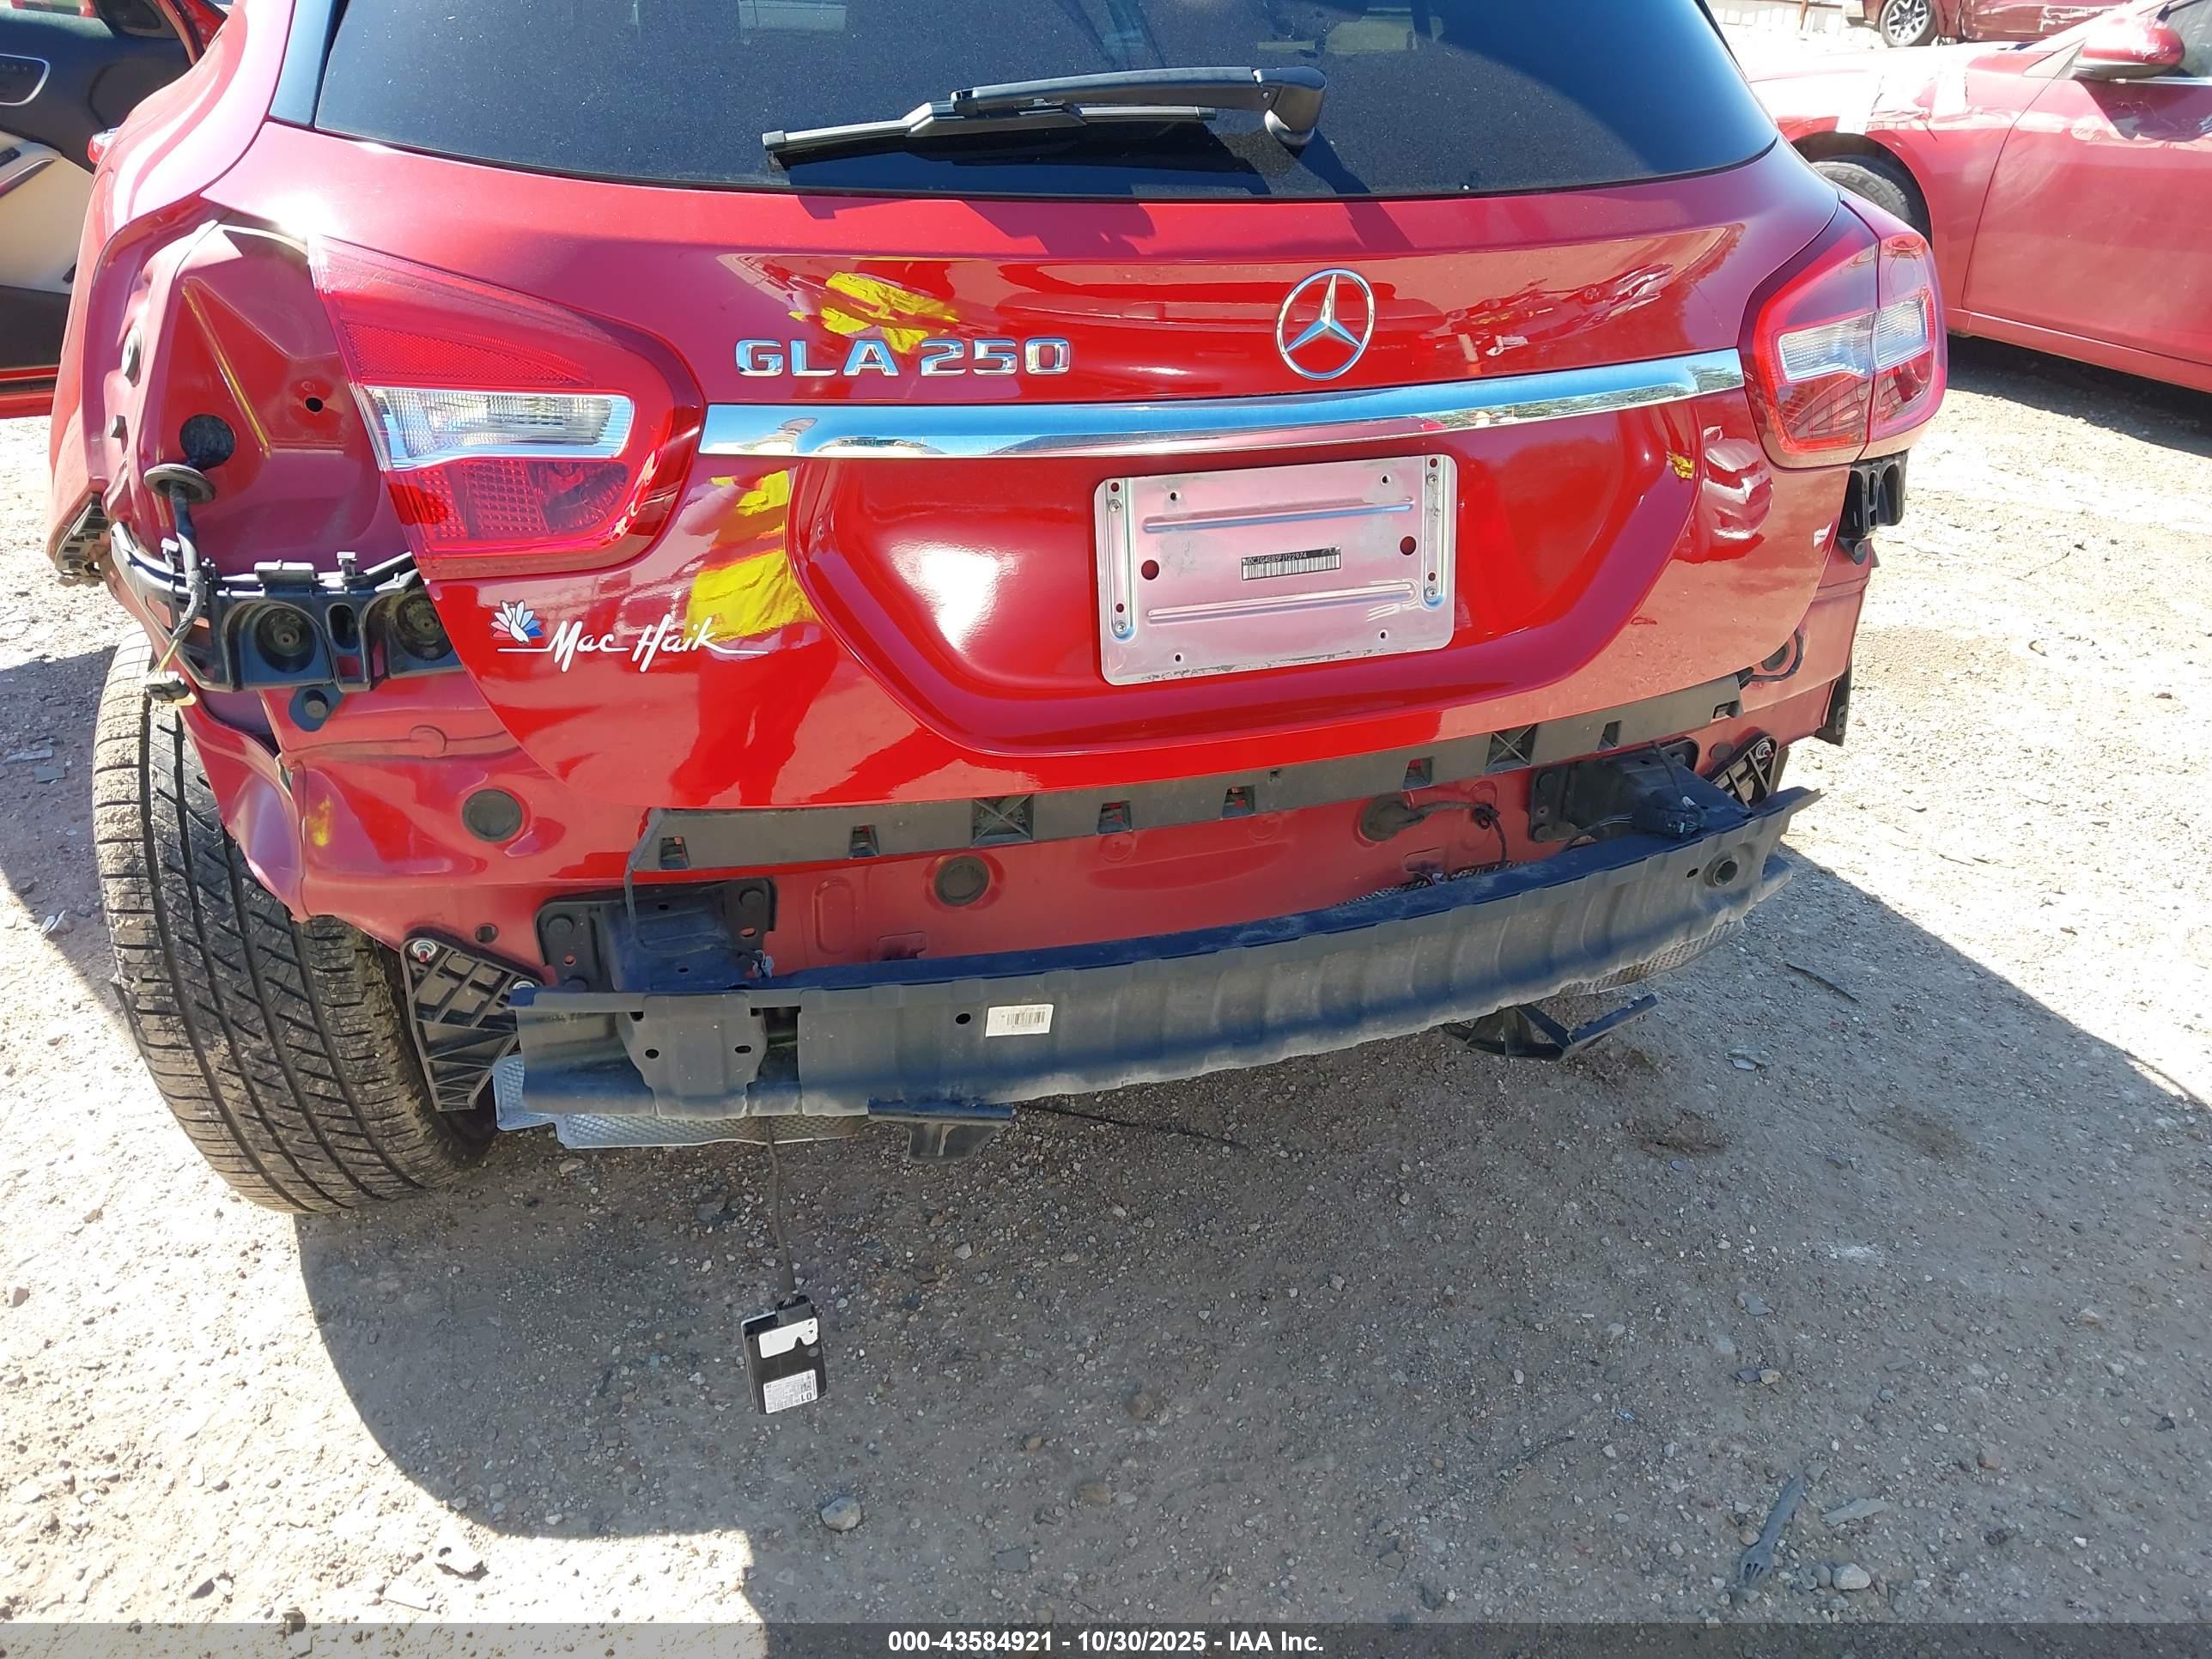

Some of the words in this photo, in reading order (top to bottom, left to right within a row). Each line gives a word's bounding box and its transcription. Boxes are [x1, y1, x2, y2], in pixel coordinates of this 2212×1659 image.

[735, 338, 900, 377] GLA
[920, 337, 1072, 376] 250
[497, 620, 629, 672] Mac
[631, 613, 769, 672] Haik
